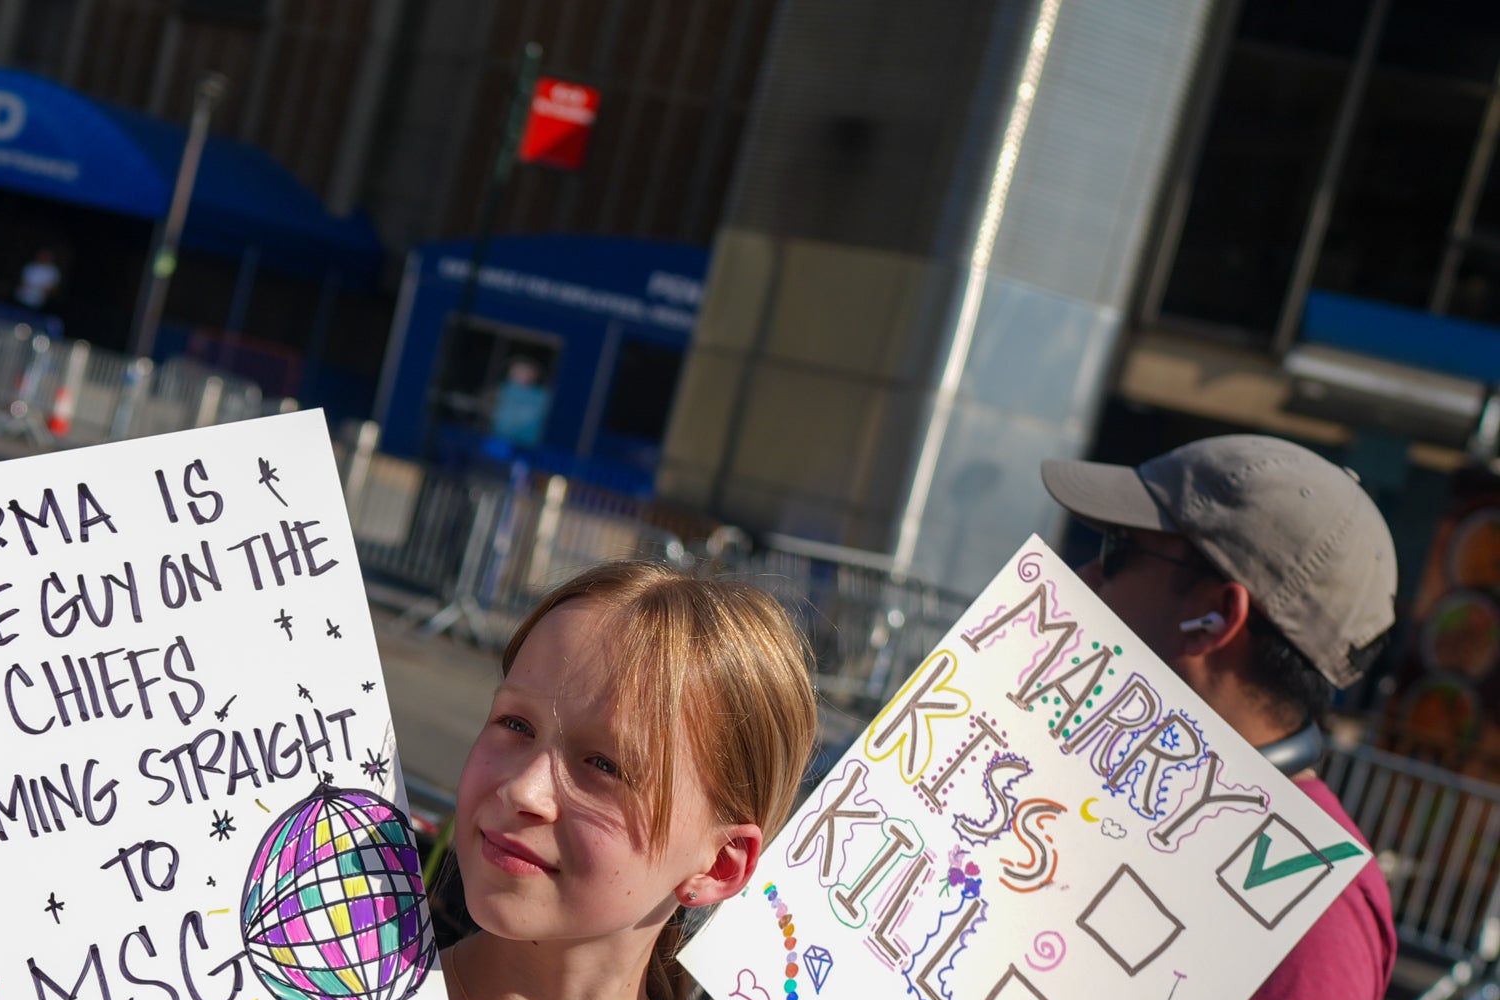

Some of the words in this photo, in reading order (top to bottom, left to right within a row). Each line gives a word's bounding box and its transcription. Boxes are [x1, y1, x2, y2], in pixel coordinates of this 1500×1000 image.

[155, 459, 224, 525] IS
[40, 561, 143, 638] GUY
[160, 541, 220, 610] ON
[228, 520, 339, 590] THE
[4, 636, 204, 735] CHIEFS
[961, 583, 1268, 845] MARRY
[138, 708, 357, 804] STRAIGHT
[873, 656, 1066, 882] KISS
[101, 840, 179, 901] TO
